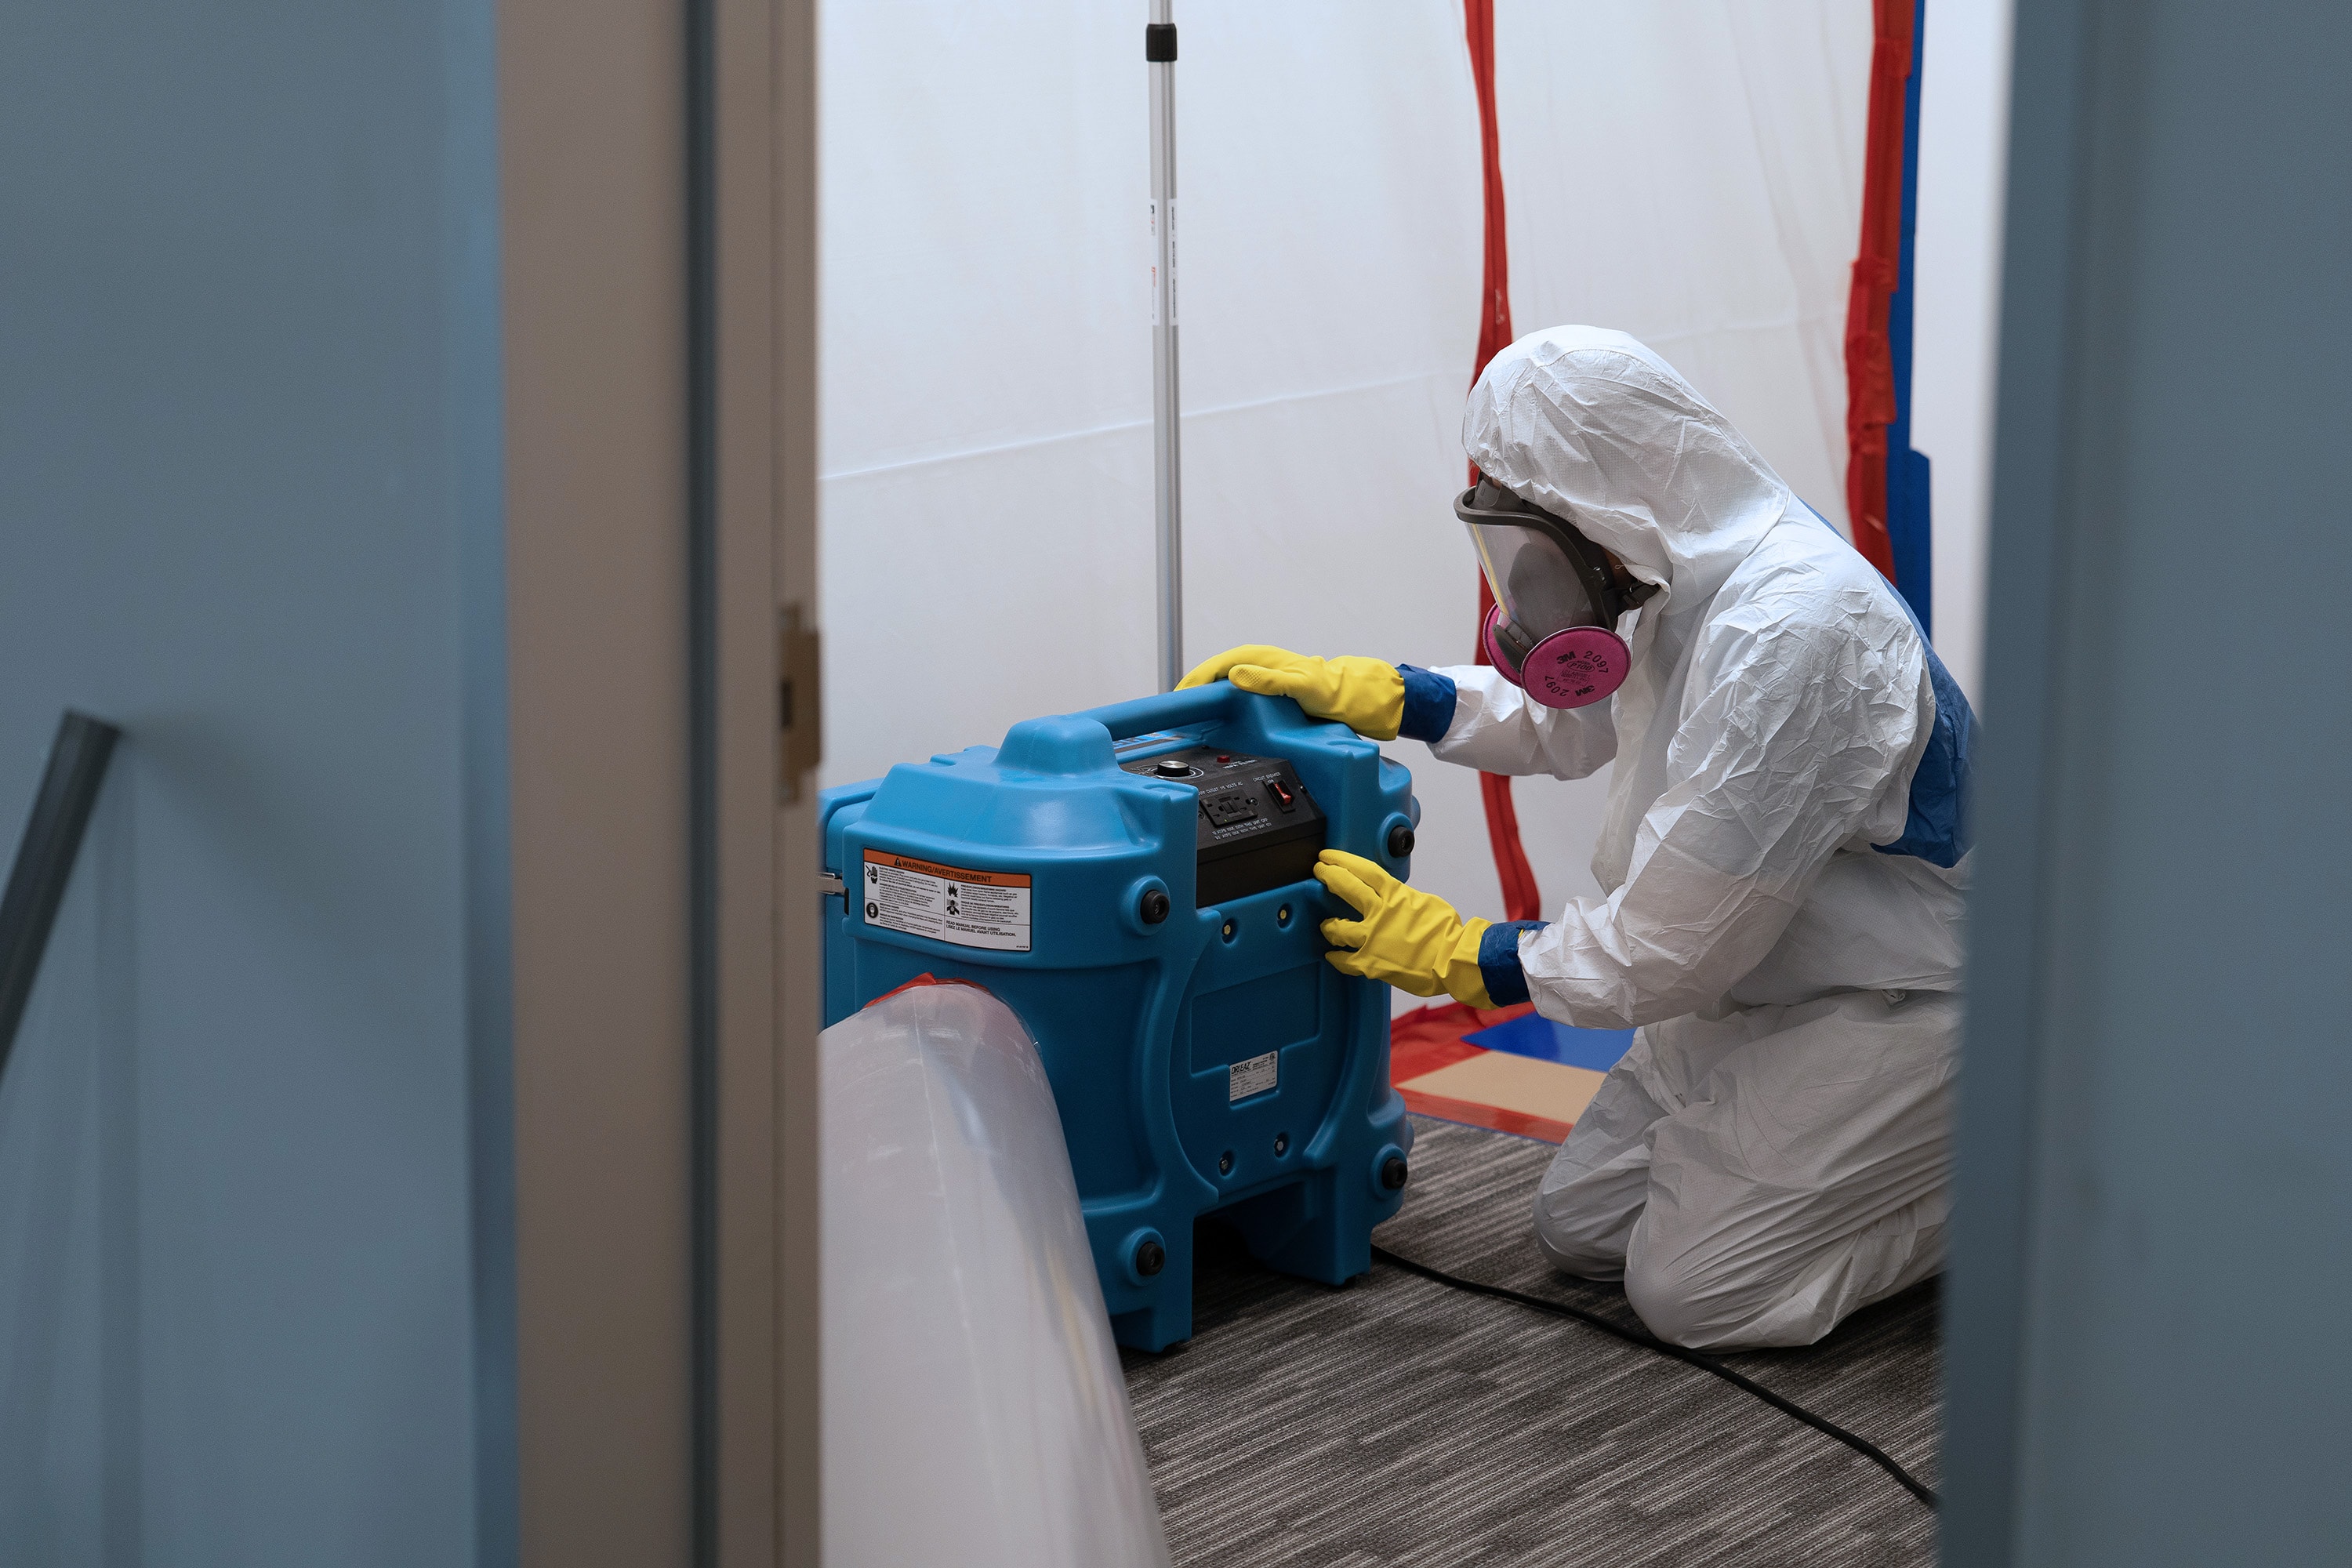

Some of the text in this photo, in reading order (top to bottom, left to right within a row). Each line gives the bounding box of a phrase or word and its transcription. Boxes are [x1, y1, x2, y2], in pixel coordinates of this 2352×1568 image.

[1556, 651, 1576, 664] 3M
[1584, 651, 1609, 673] 2097
[1570, 662, 1592, 671] P100
[1544, 676, 1570, 697] 2097
[1575, 685, 1595, 696] 3M
[902, 860, 992, 883] WARNING/AVERTISSEMENT
